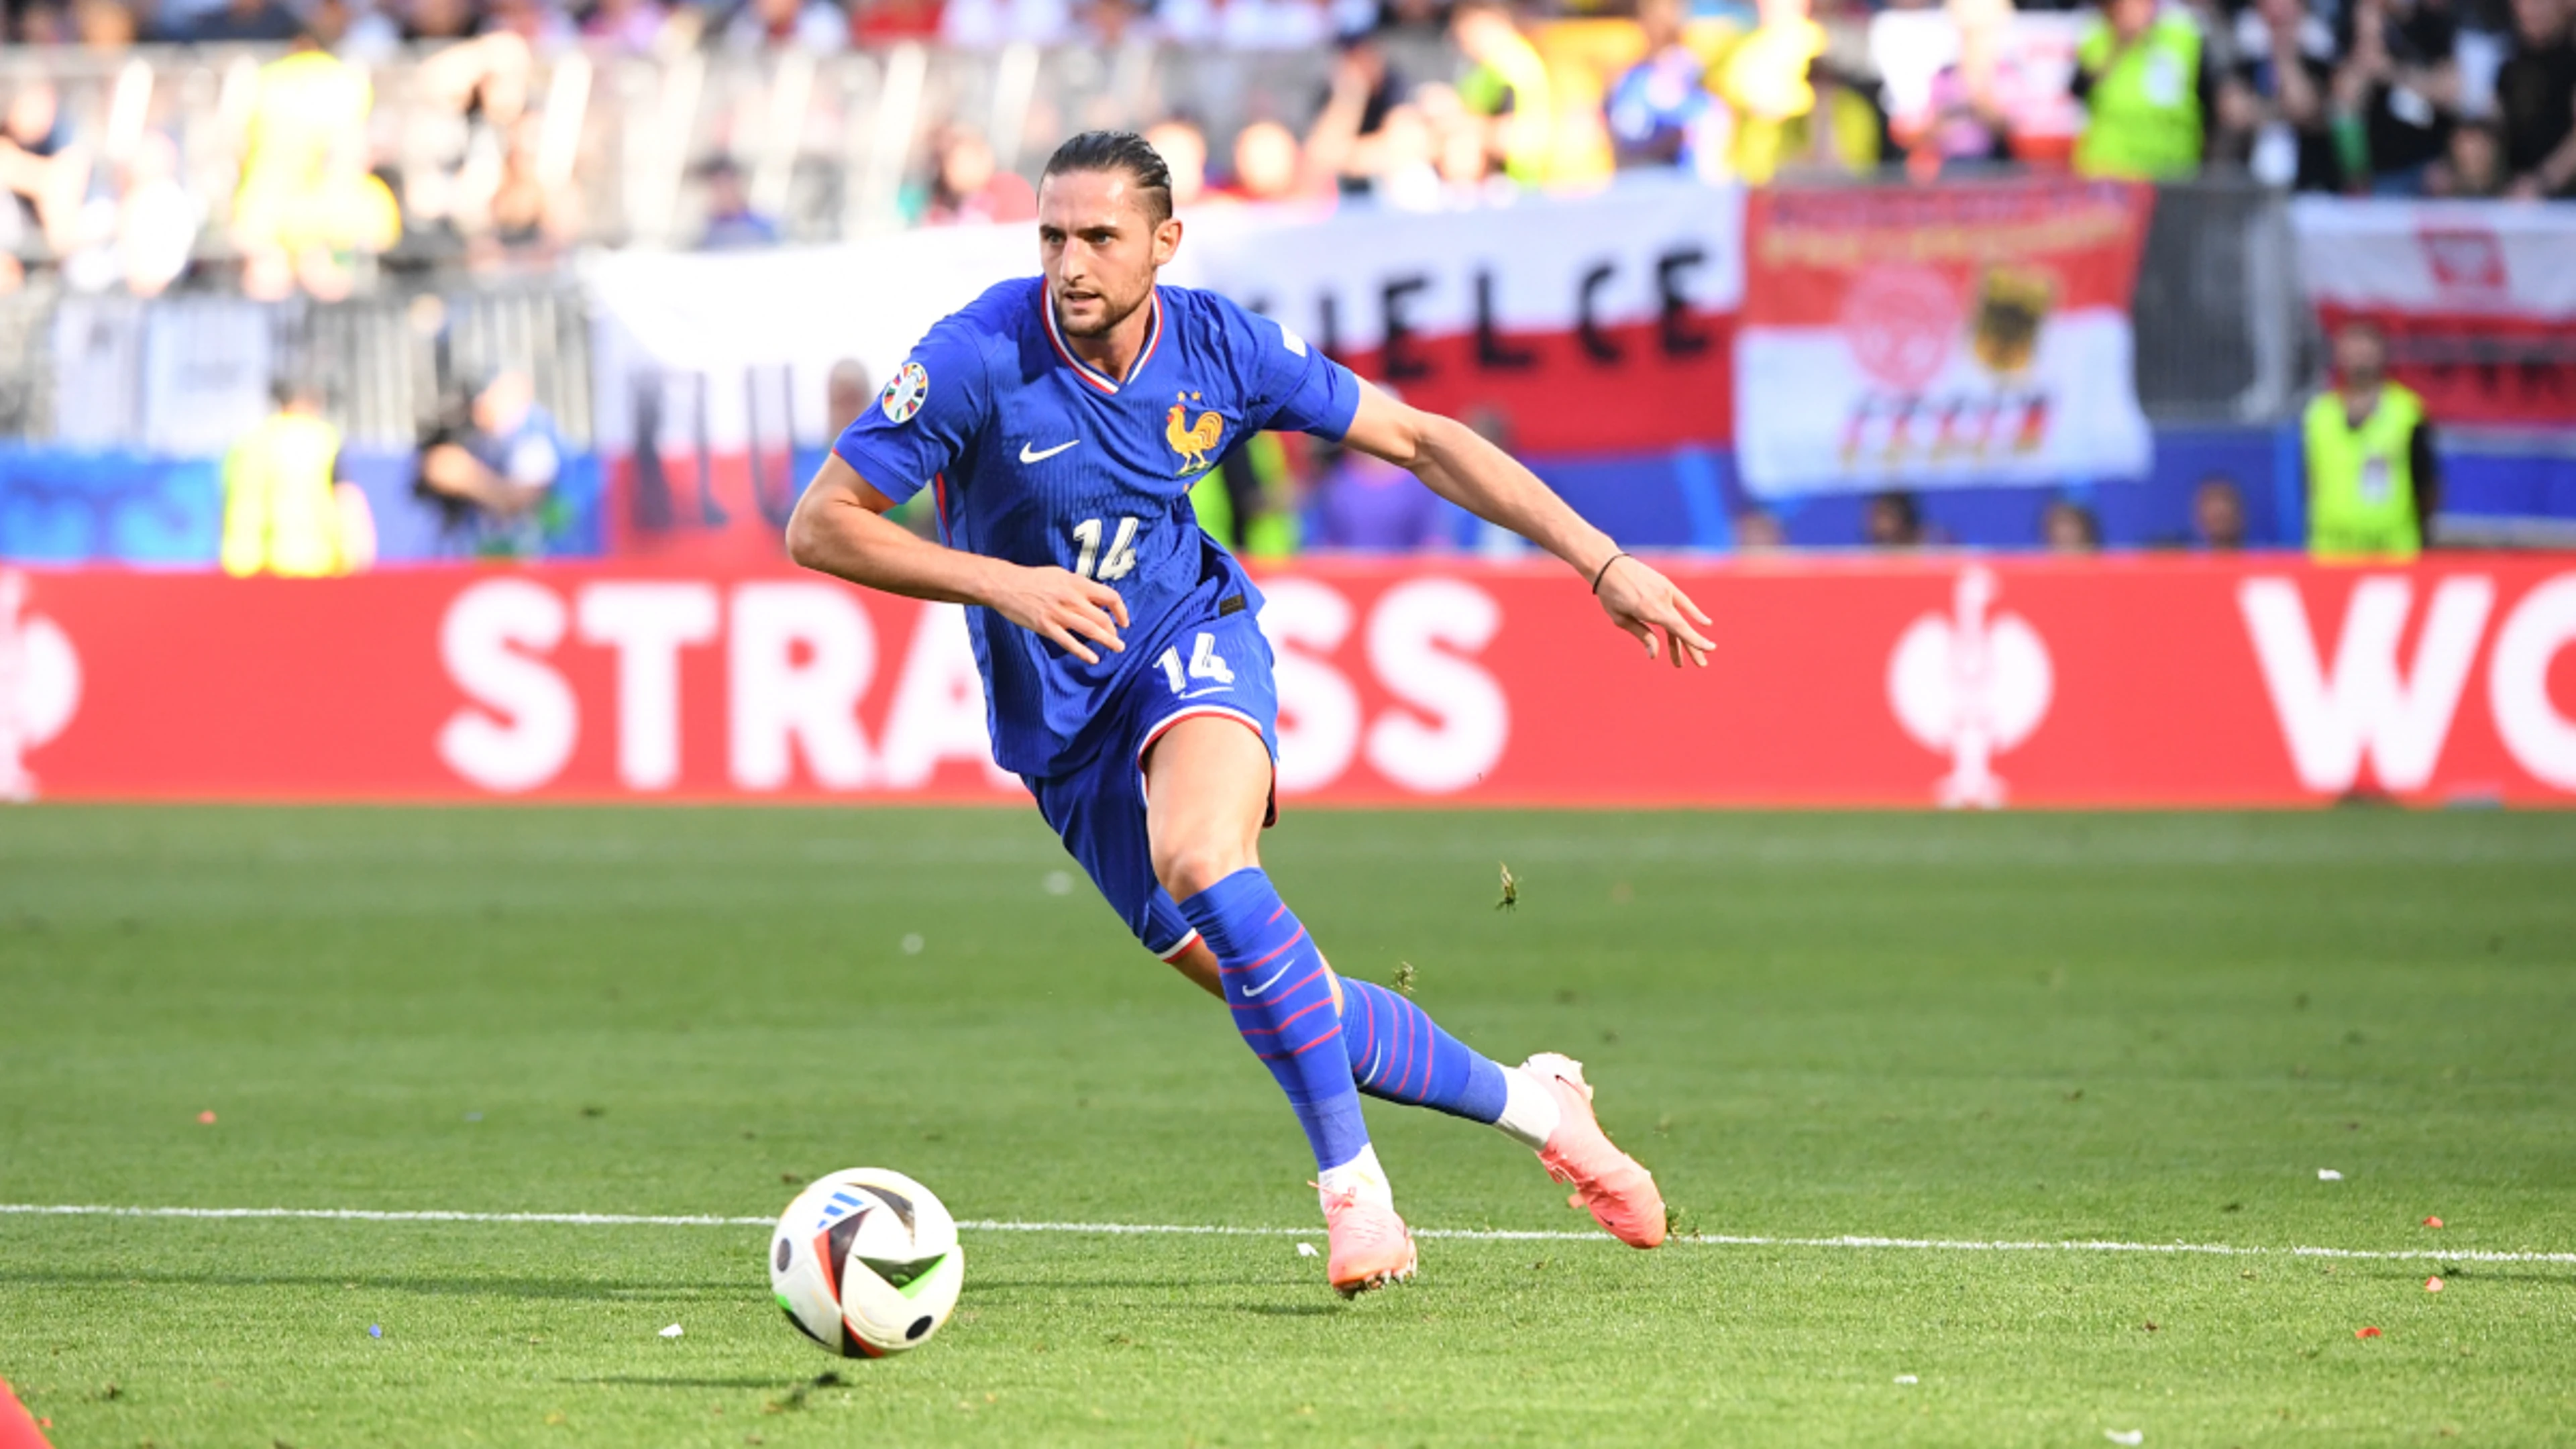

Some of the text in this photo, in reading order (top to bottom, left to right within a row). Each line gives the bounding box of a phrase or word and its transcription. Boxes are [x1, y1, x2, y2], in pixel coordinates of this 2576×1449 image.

[1249, 247, 1709, 382] IELCE
[1073, 517, 1139, 580] 14
[1152, 632, 1235, 694] 14
